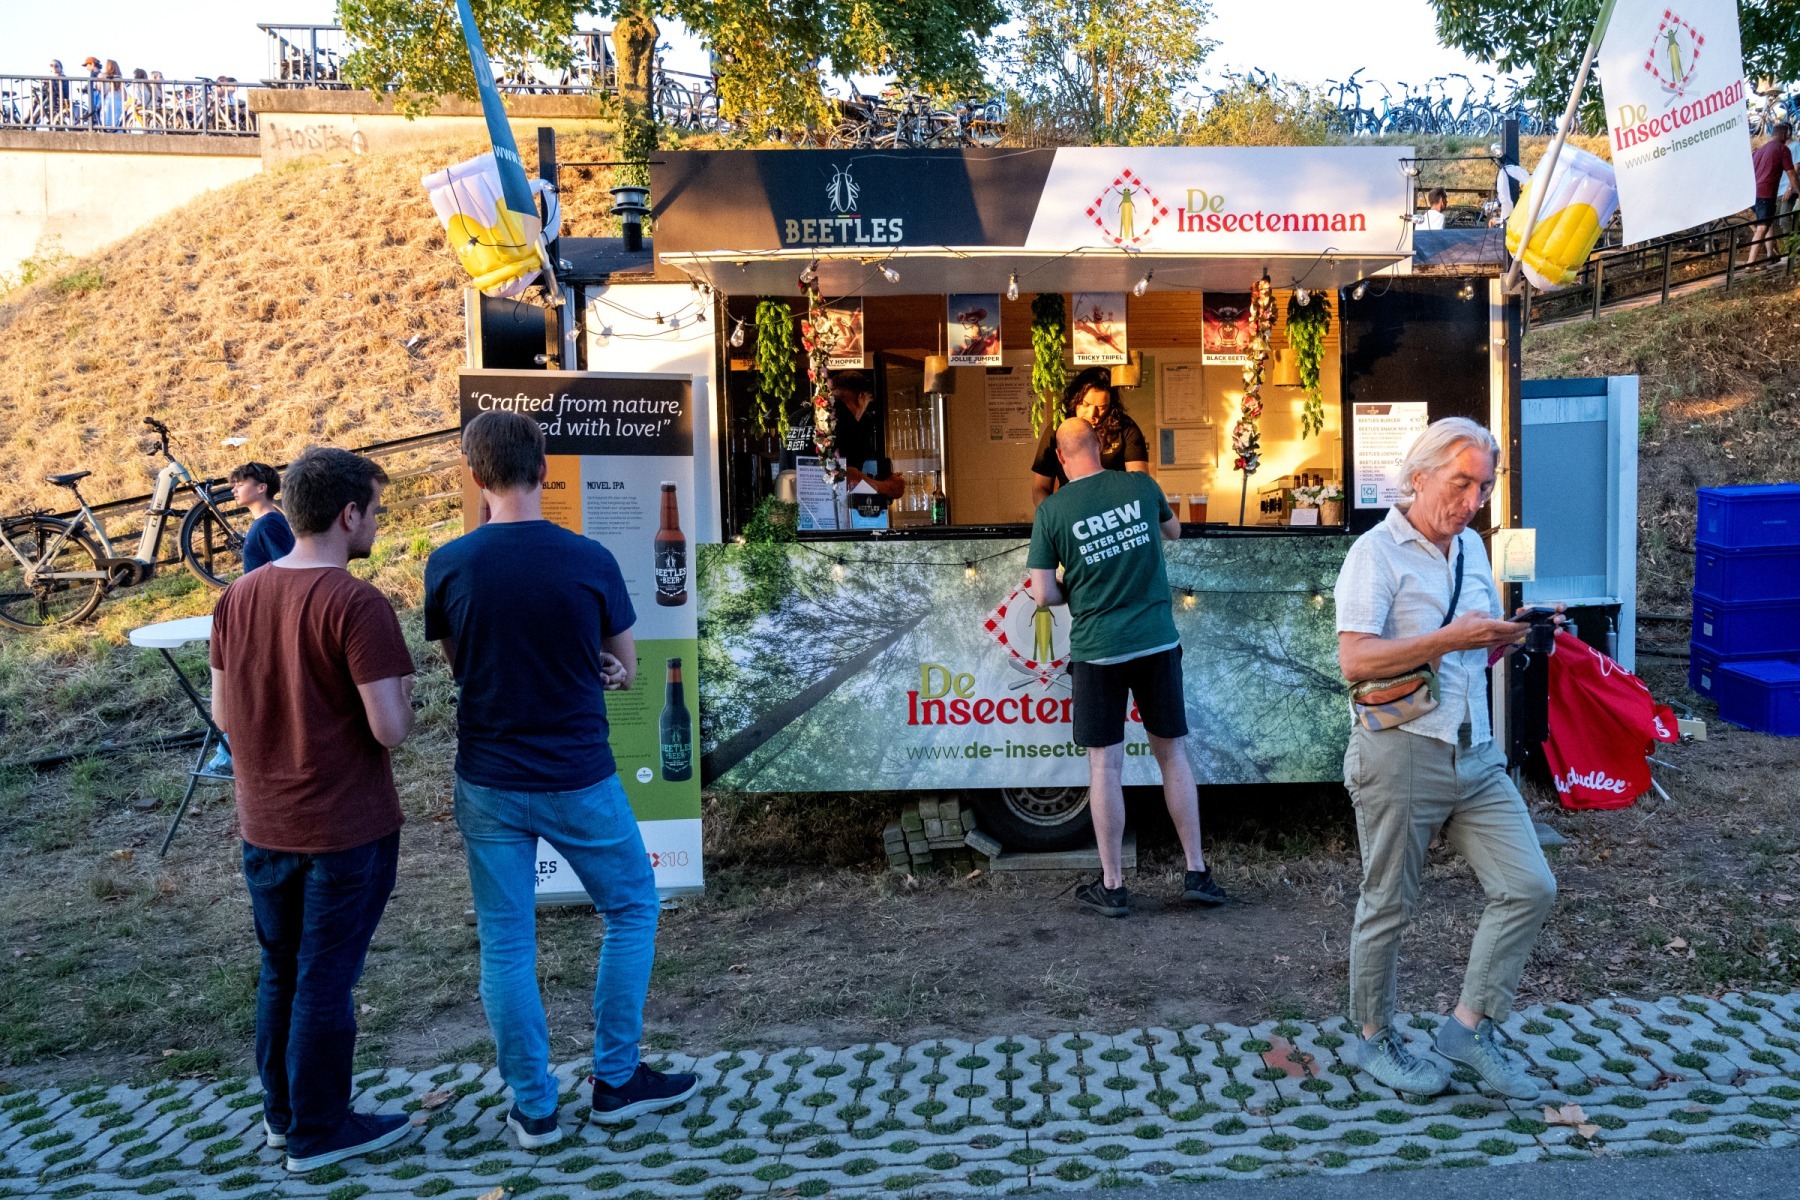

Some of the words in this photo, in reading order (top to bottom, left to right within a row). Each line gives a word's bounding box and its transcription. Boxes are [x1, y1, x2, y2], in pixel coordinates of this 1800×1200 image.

[1613, 79, 1744, 151] Insectenman
[1618, 103, 1649, 131] De
[1186, 188, 1225, 214] De
[785, 218, 903, 244] BEETLES
[1177, 208, 1367, 233] Insectenman
[558, 393, 608, 417] from
[612, 398, 683, 417] nature,
[567, 418, 611, 436] with
[615, 419, 671, 437] love!”
[786, 426, 817, 439] EETLES
[542, 481, 566, 490] BLOND
[586, 481, 611, 490] NOVEL
[613, 481, 625, 490] IPA
[1072, 500, 1142, 540] CREW
[1079, 534, 1116, 555] BETER
[1115, 522, 1149, 541] BORD
[1084, 545, 1121, 566] BETER
[1121, 533, 1151, 552] ETEN
[919, 663, 976, 700] De
